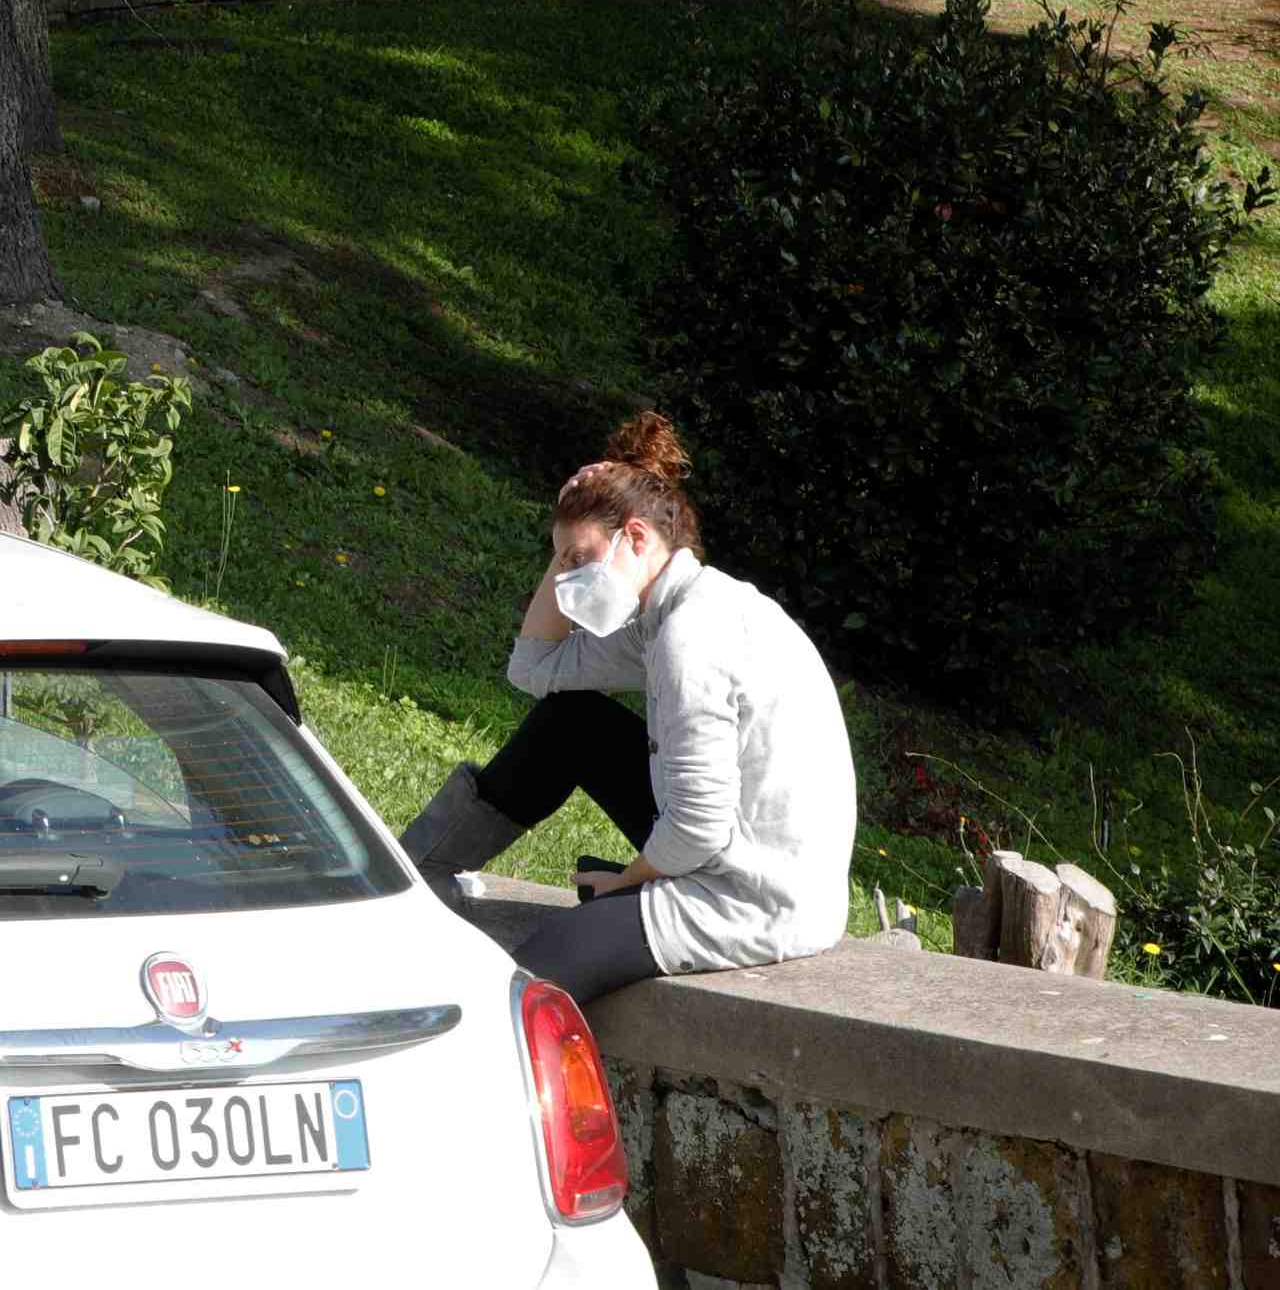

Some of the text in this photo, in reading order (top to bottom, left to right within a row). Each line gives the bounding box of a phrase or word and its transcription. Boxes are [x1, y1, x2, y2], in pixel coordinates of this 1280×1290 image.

[155, 970, 199, 1006] FIAT
[51, 1103, 124, 1178] FC
[147, 1092, 329, 1171] 030LN
